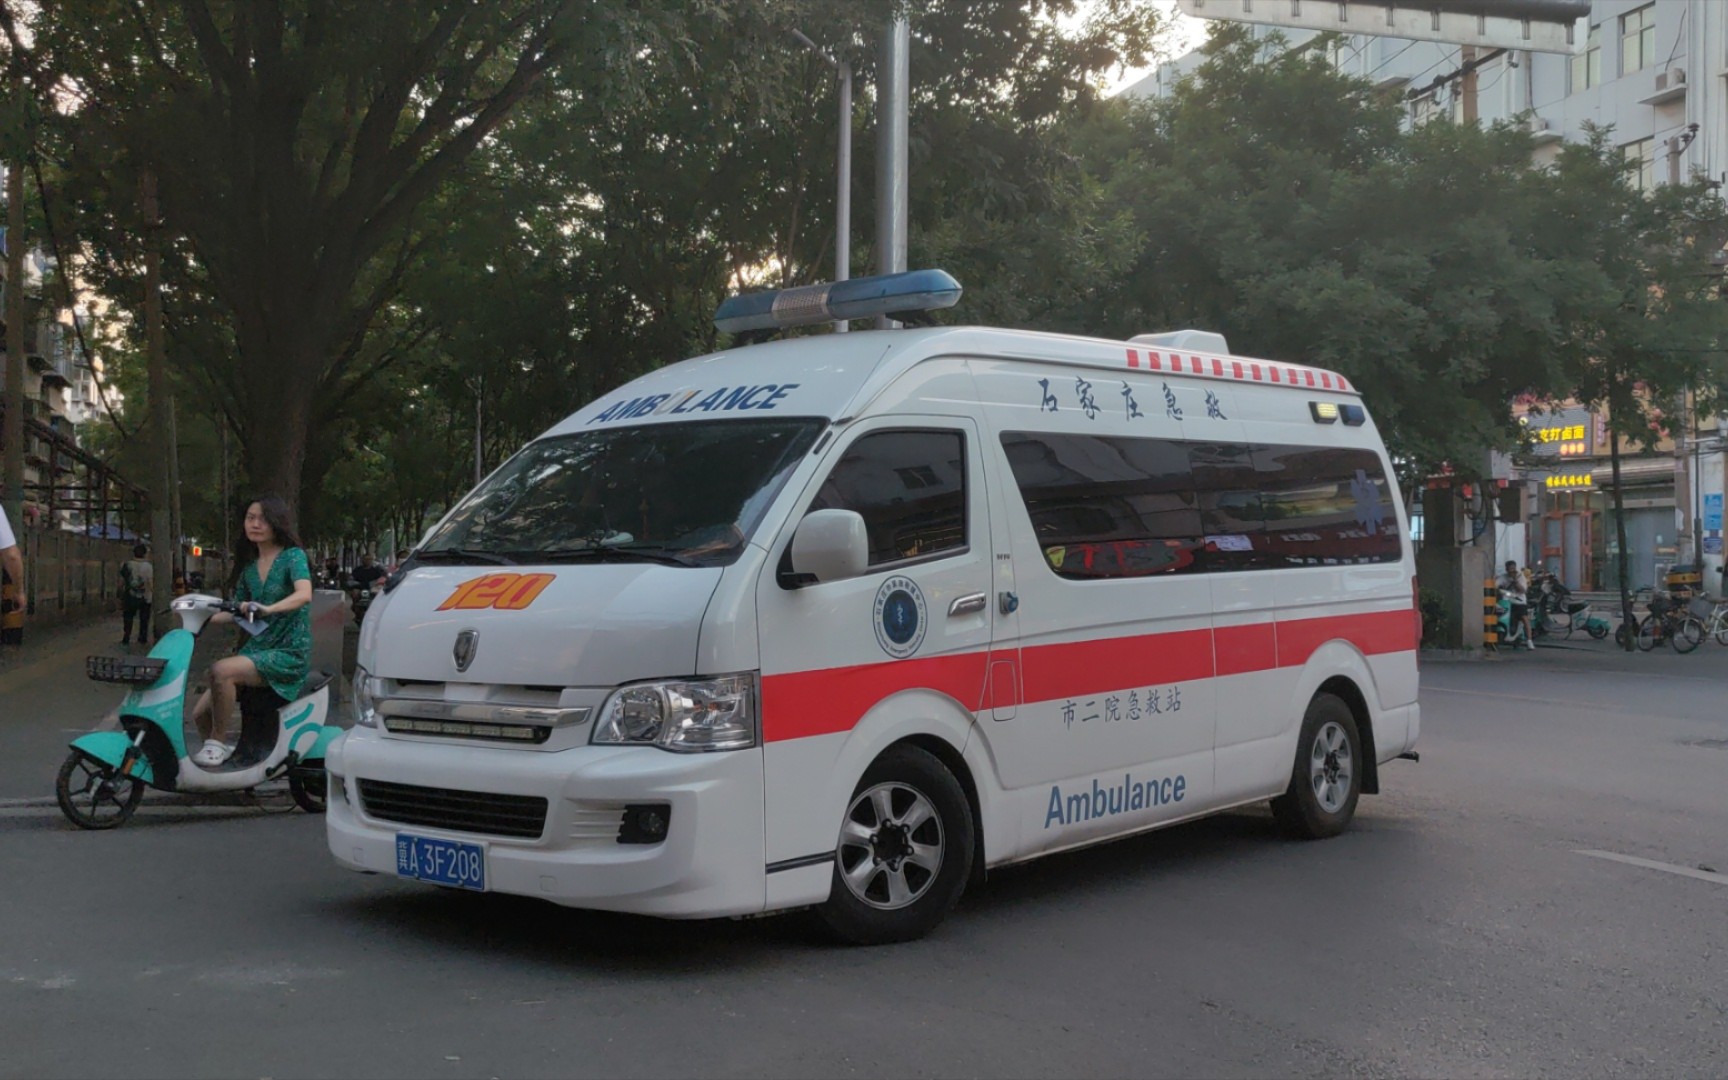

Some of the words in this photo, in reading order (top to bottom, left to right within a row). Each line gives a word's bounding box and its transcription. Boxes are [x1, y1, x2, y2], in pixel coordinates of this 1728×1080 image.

[586, 384, 800, 425] AMBULANCE
[1038, 376, 1228, 421] 石家庄急救
[434, 573, 557, 611] 120
[1061, 685, 1182, 731] 市二院急救站
[1044, 773, 1186, 829] Ambulance
